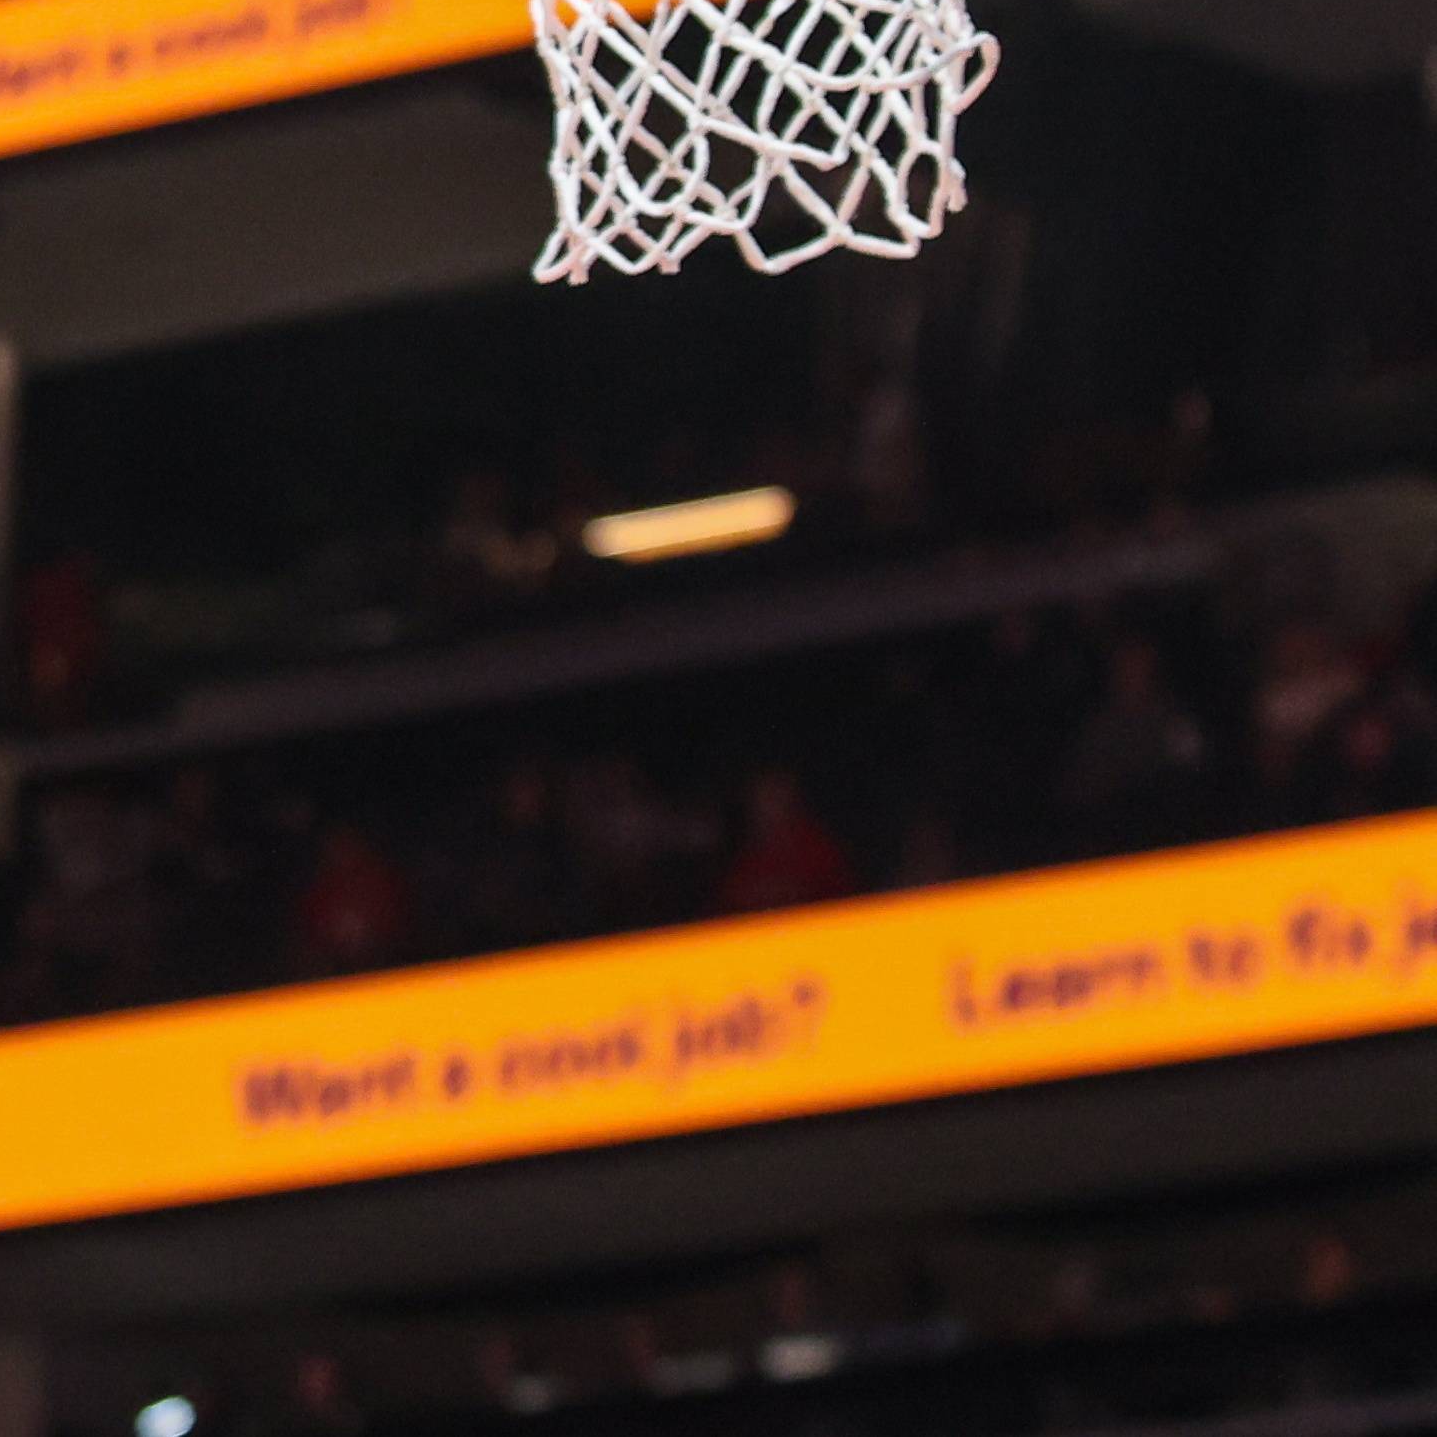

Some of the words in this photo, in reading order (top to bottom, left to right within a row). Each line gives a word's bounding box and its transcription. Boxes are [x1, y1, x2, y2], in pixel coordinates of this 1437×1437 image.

[950, 955, 1158, 1028] Learn
[1186, 931, 1254, 984] to
[1289, 904, 1372, 962] fix
[243, 1058, 415, 1123] Want
[443, 1060, 470, 1099] a
[499, 1023, 642, 1088] cool
